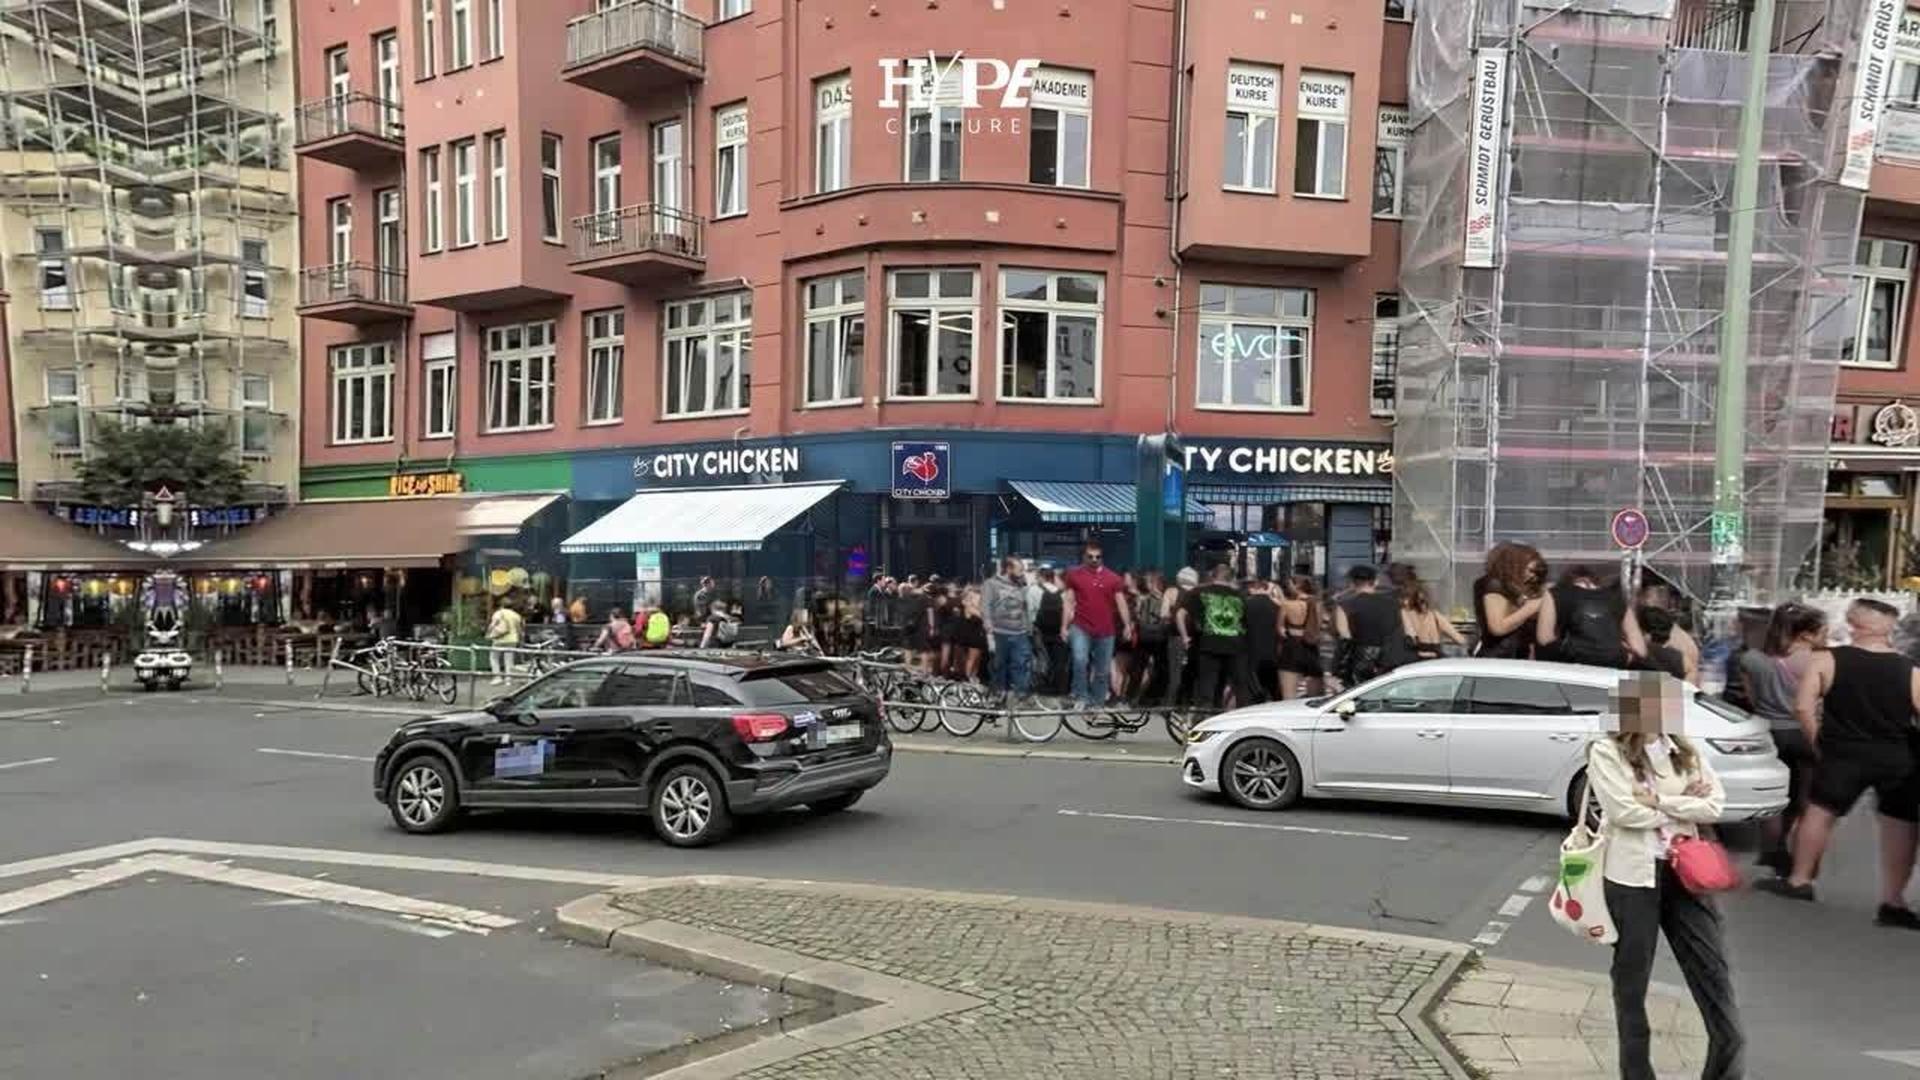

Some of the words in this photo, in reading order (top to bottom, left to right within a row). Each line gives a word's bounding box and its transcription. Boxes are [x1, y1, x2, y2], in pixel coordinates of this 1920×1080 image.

[1033, 79, 1087, 98] AKADEMIE
[1230, 73, 1274, 88] DEUTSCH
[1300, 81, 1346, 96] ENGLISCH
[1860, 53, 1884, 121] SCHMIDT
[1235, 88, 1267, 101] KURSE
[1305, 97, 1337, 109] KURSE
[1480, 60, 1498, 141] GERÜSTBAU
[1475, 145, 1491, 206] SCHMIDT
[653, 453, 699, 478] CITY
[702, 447, 799, 475] CHICKEN
[1183, 446, 1223, 472] TY
[1228, 447, 1374, 475] CHICKEN
[894, 488, 912, 496] CITY
[912, 488, 946, 496] CHICKEN
